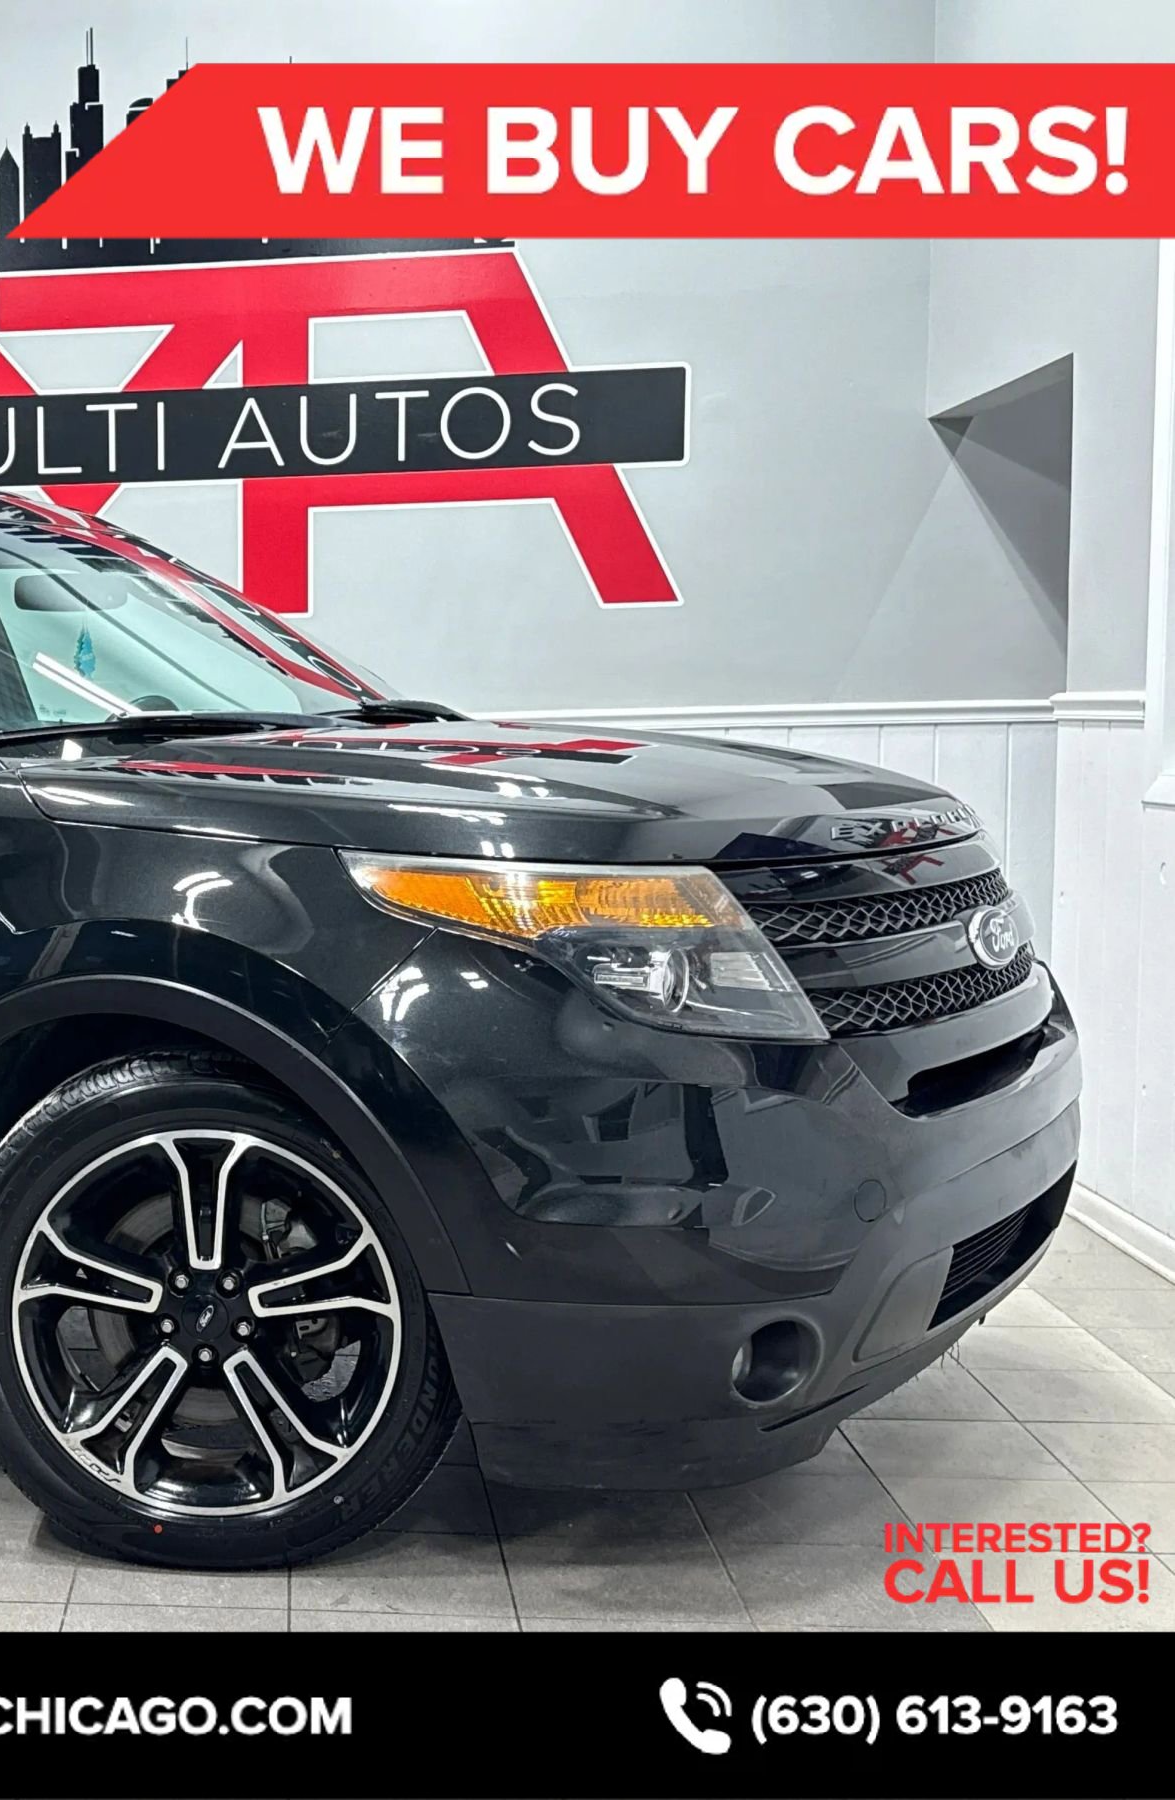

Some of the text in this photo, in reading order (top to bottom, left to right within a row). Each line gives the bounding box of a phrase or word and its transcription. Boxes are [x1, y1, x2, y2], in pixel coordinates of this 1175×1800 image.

[217, 383, 581, 469] AUTOS
[989, 918, 1015, 953] Ford
[339, 1320, 442, 1523] UNDERER
